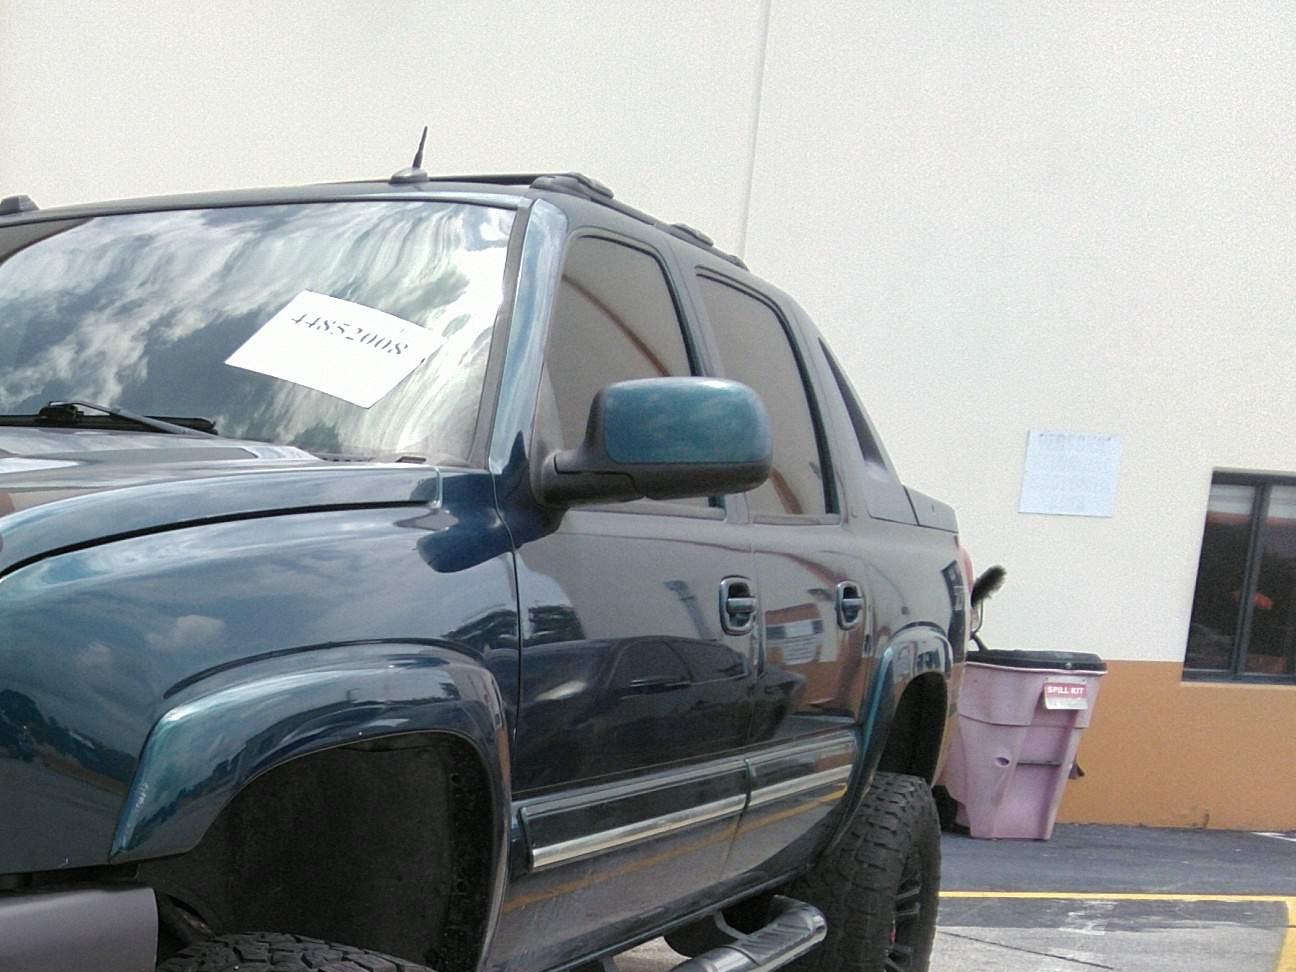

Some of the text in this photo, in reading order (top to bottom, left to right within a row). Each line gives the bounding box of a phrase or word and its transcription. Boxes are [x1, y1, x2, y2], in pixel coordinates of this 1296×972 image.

[290, 313, 409, 355] 44852008
[1047, 686, 1084, 695] SPILL KIT
